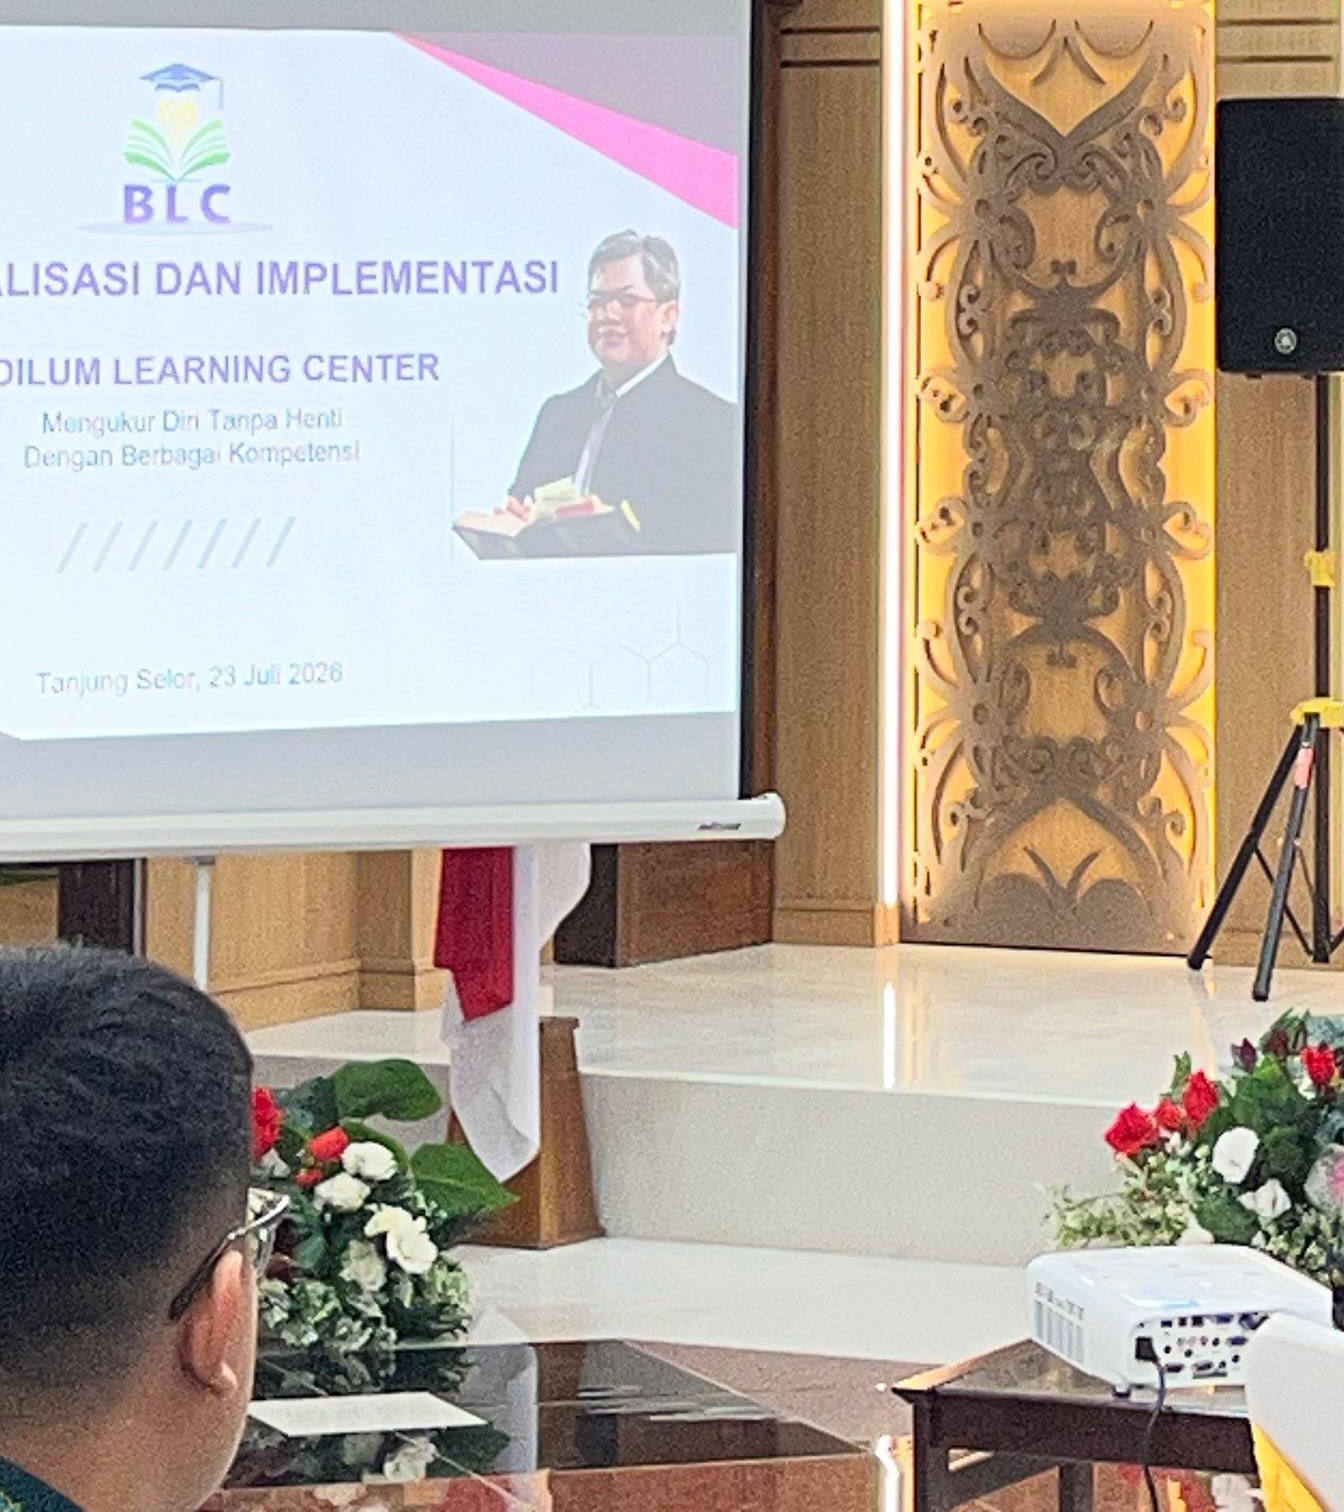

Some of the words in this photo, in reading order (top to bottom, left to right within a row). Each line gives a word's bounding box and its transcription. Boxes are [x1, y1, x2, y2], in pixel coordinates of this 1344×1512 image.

[122, 183, 233, 225] BLC
[155, 261, 242, 296] DAN
[257, 260, 558, 295] IMPLEMENTASI
[113, 355, 292, 386] LEARNING
[303, 353, 440, 384] CENTER
[207, 408, 279, 437] Tanpa
[285, 407, 344, 431] Henti
[23, 445, 114, 473] Dengan
[122, 443, 223, 471] Berbagai
[36, 669, 129, 700] Tanjung
[209, 664, 236, 689] 23
[244, 662, 281, 687] Juli
